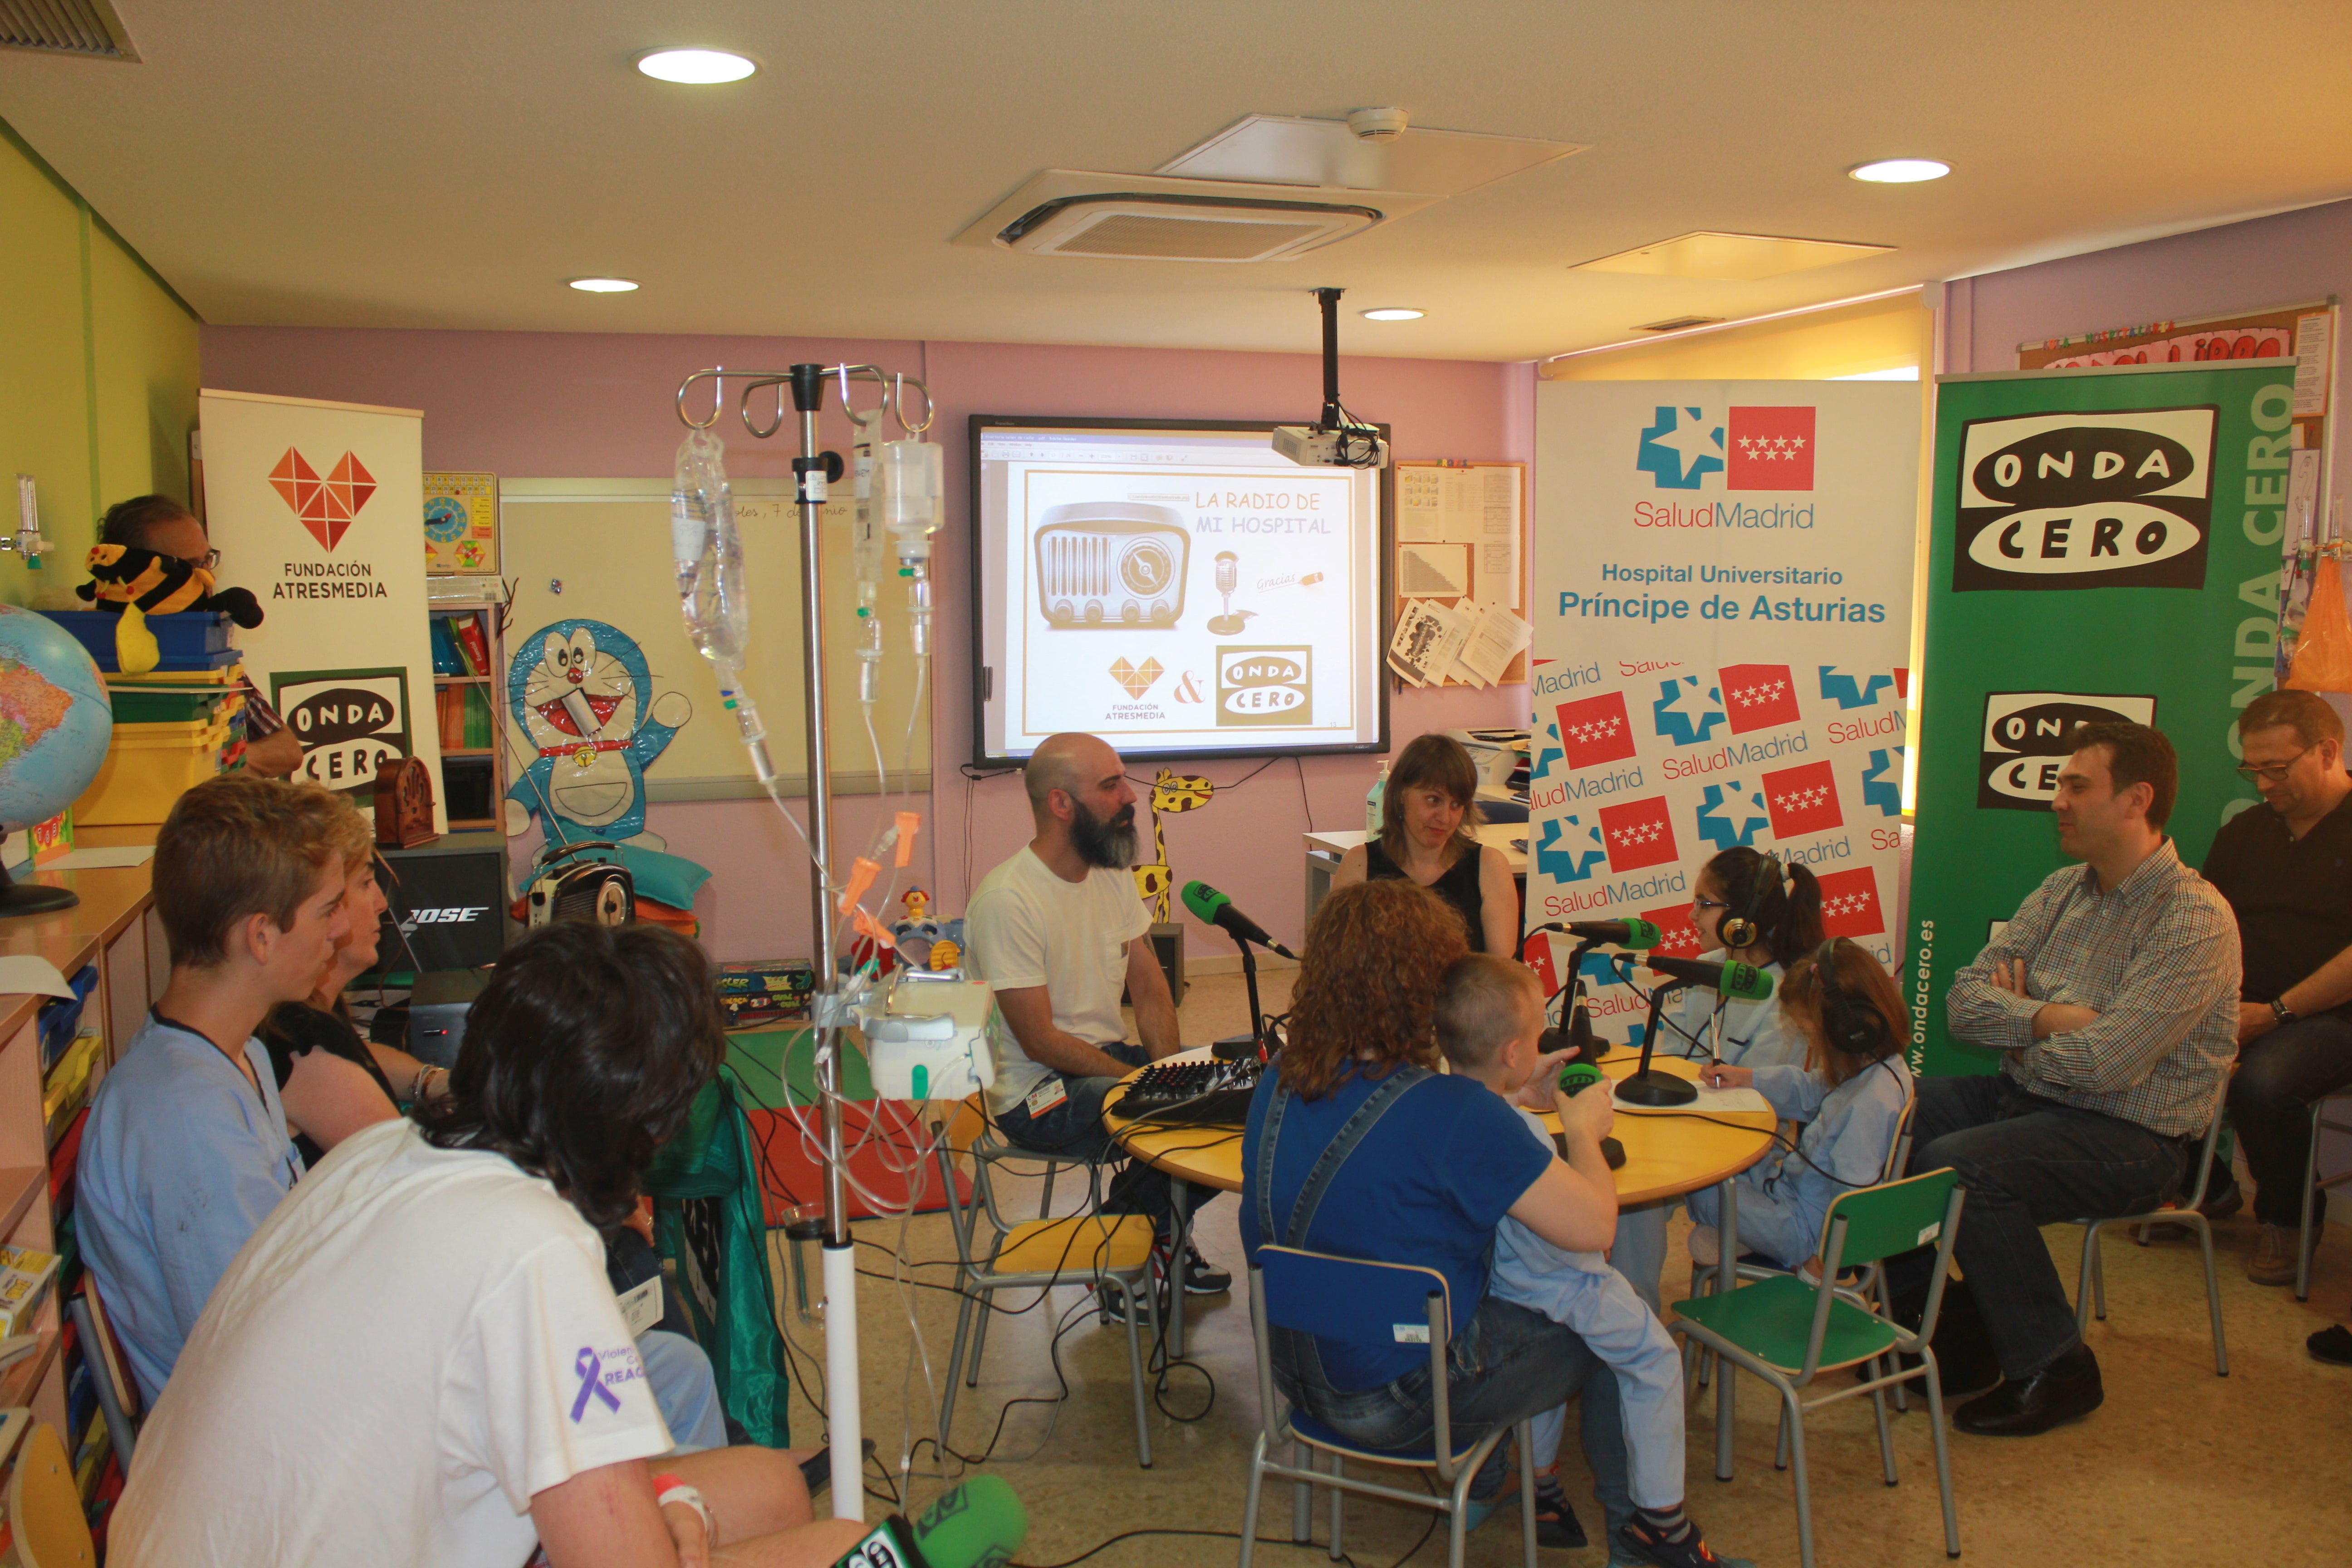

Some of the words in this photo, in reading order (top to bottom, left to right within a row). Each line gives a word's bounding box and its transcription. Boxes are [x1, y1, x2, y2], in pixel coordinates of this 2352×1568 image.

[2042, 337, 2070, 350] AULA
[2085, 320, 2176, 344] HOSPITALARIA
[1994, 449, 2171, 488] ONDA
[2243, 384, 2293, 546] CERO
[1196, 491, 1219, 508] LA
[1226, 492, 1290, 509] RADIO
[1297, 493, 1320, 510] DE
[1196, 516, 1223, 533] MI
[1232, 516, 1332, 534] HOSPITAL
[1633, 501, 1814, 529] SaludMadrid
[1999, 518, 2167, 559] CERO
[285, 560, 372, 577] FUNDACIÓN
[1257, 573, 1296, 590] Gracias
[1602, 563, 1693, 587] Hospital
[1701, 565, 1843, 585] Universitario
[273, 581, 387, 599] ATRESMEDIA
[1558, 591, 1689, 624] Príncipe
[1700, 593, 1740, 620] de
[1749, 595, 1886, 623] Asturias
[1232, 665, 1294, 680] ONDA
[1236, 691, 1294, 708] CERO
[296, 702, 384, 732] ONDA
[1105, 711, 1166, 720] ATRESMEDIA
[306, 749, 387, 781] CERO
[1662, 730, 1808, 780] SaludMadrid
[1544, 871, 1686, 917] SaludMadrid
